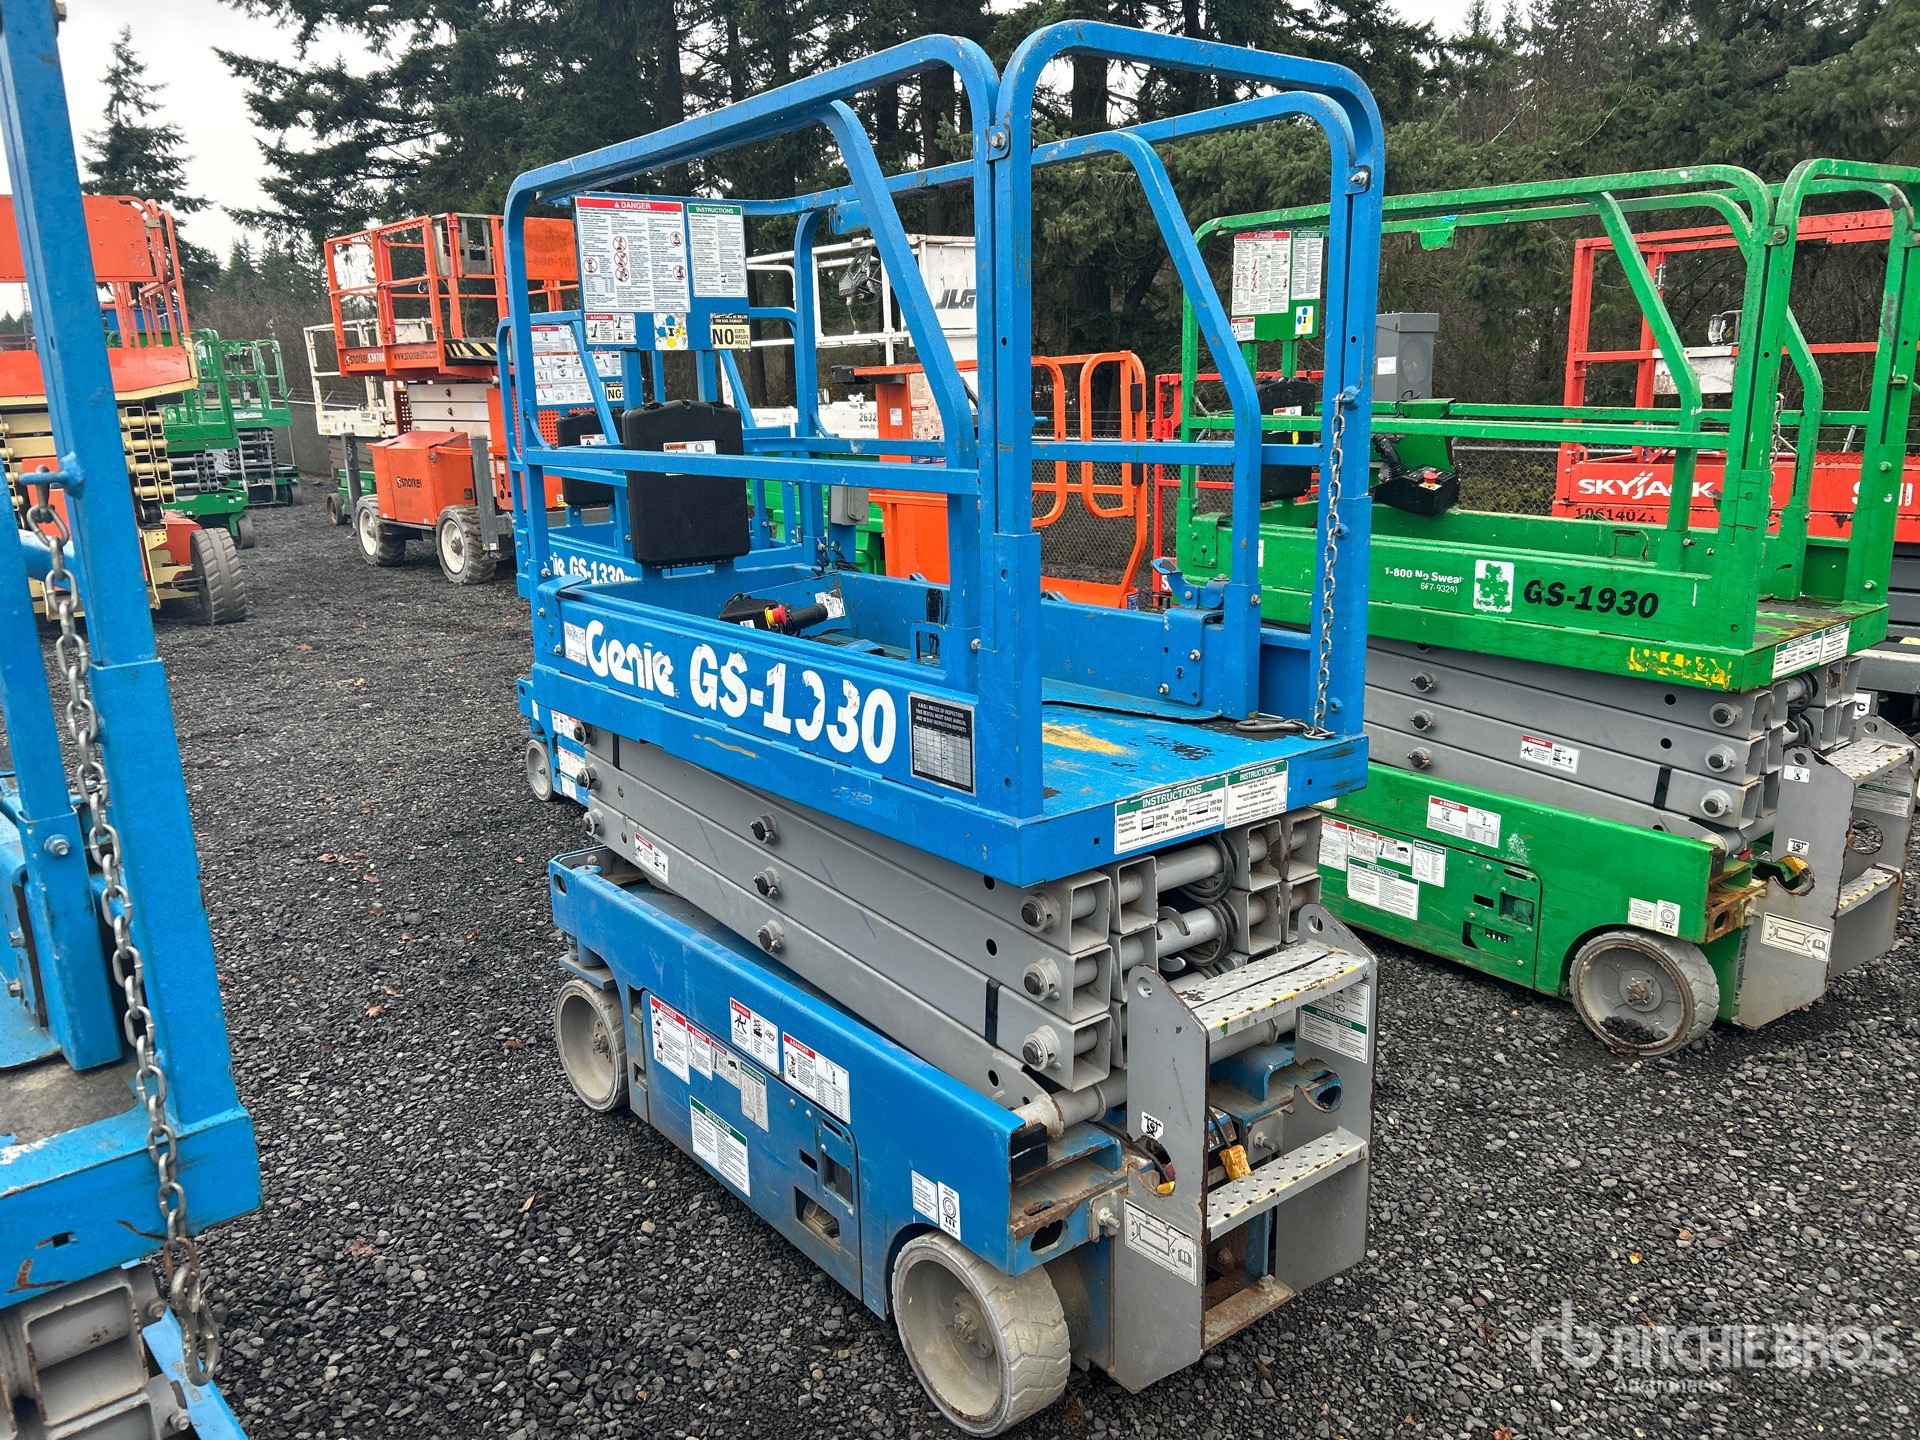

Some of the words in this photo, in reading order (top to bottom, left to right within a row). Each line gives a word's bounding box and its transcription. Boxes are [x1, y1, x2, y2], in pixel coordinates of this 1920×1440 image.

[935, 289, 976, 309] JLG
[712, 329, 734, 345] NO
[1578, 471, 1714, 499] SKYJAK
[1385, 567, 1412, 578] 1-800
[1524, 580, 1660, 618] GS-1930
[585, 620, 675, 698] Genie
[1240, 766, 1276, 781] INSTRUCTIONS
[1142, 784, 1202, 808] INSTRUCTIONS
[1367, 864, 1399, 878] INSTRUCTIONS
[1316, 1010, 1353, 1028] INSTRUCTIONS
